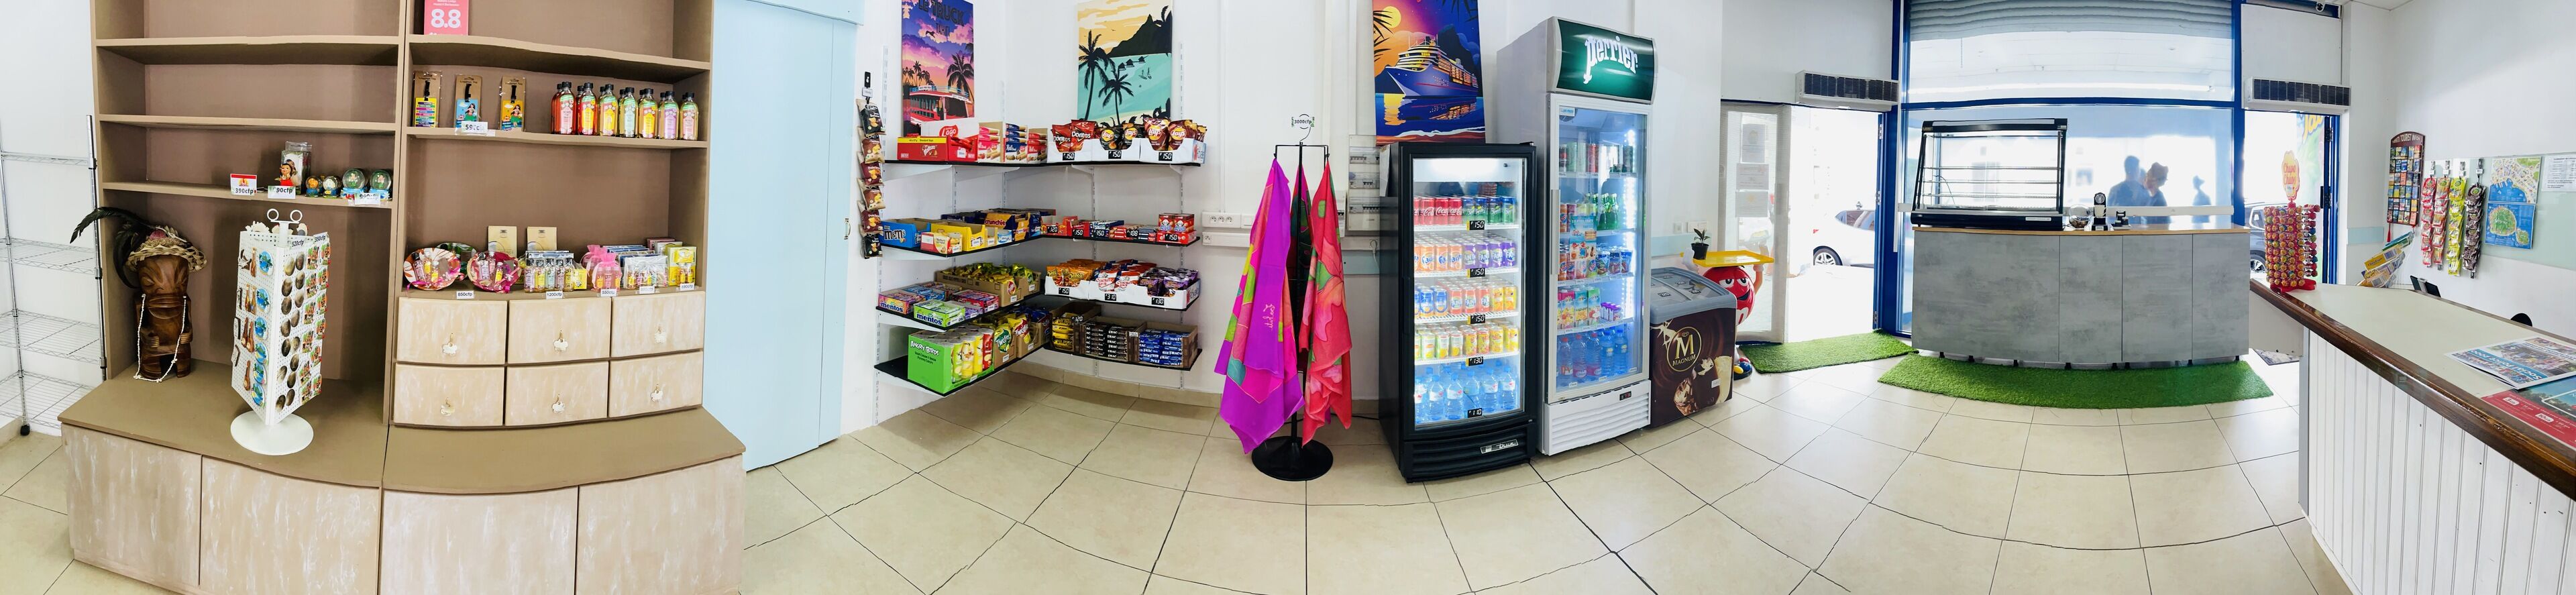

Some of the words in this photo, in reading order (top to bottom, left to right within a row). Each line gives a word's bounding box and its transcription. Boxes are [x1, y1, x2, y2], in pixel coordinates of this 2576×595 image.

[431, 9, 461, 28] 8.8
[931, 1, 965, 27] TRUCK
[936, 23, 950, 36] TAHITI
[1583, 36, 1638, 85] perrier
[942, 128, 956, 137] Lago
[881, 302, 904, 313] mentos
[917, 313, 943, 325] mentos
[910, 341, 925, 351] ANGRY
[926, 346, 939, 356] BIRDS
[1672, 354, 1696, 366] MAGNUM
[2515, 366, 2542, 380] Social
